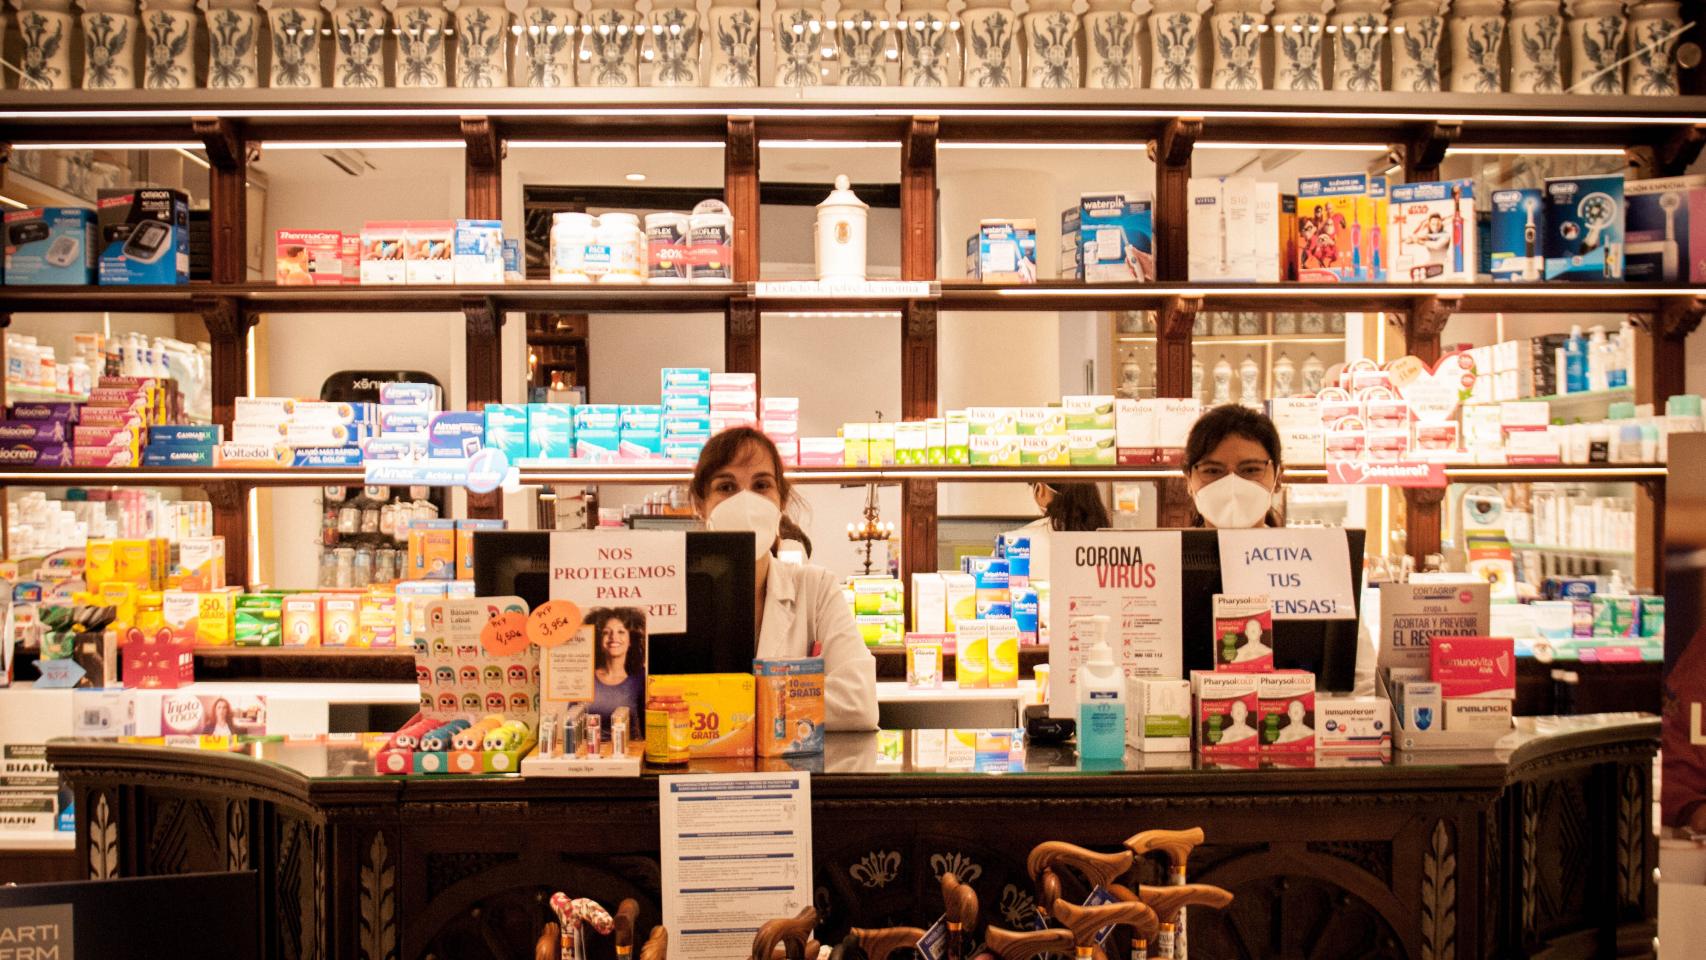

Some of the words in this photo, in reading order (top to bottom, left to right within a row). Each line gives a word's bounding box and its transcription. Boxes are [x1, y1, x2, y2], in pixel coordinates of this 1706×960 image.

[1084, 195, 1124, 209] waterpik
[280, 232, 339, 240] ThermaCare
[223, 448, 269, 458] Voltadol
[598, 548, 633, 560] NOS
[1075, 546, 1143, 567] CORONA
[1245, 547, 1312, 564] ¡ACTIVA
[554, 565, 676, 580] PROTEGEMOS
[1096, 563, 1156, 588] VIRUS
[1267, 573, 1301, 588] TUS
[596, 586, 642, 599] PARA
[647, 603, 677, 616] RTE
[1393, 618, 1429, 629] ACORTAR
[1440, 617, 1477, 628] PREVENIR
[1393, 630, 1405, 646] EL
[789, 688, 821, 698] GRATIS
[168, 700, 199, 714] Tripto
[691, 731, 719, 740] GRATIS
[0, 816, 36, 824] IAFIN
